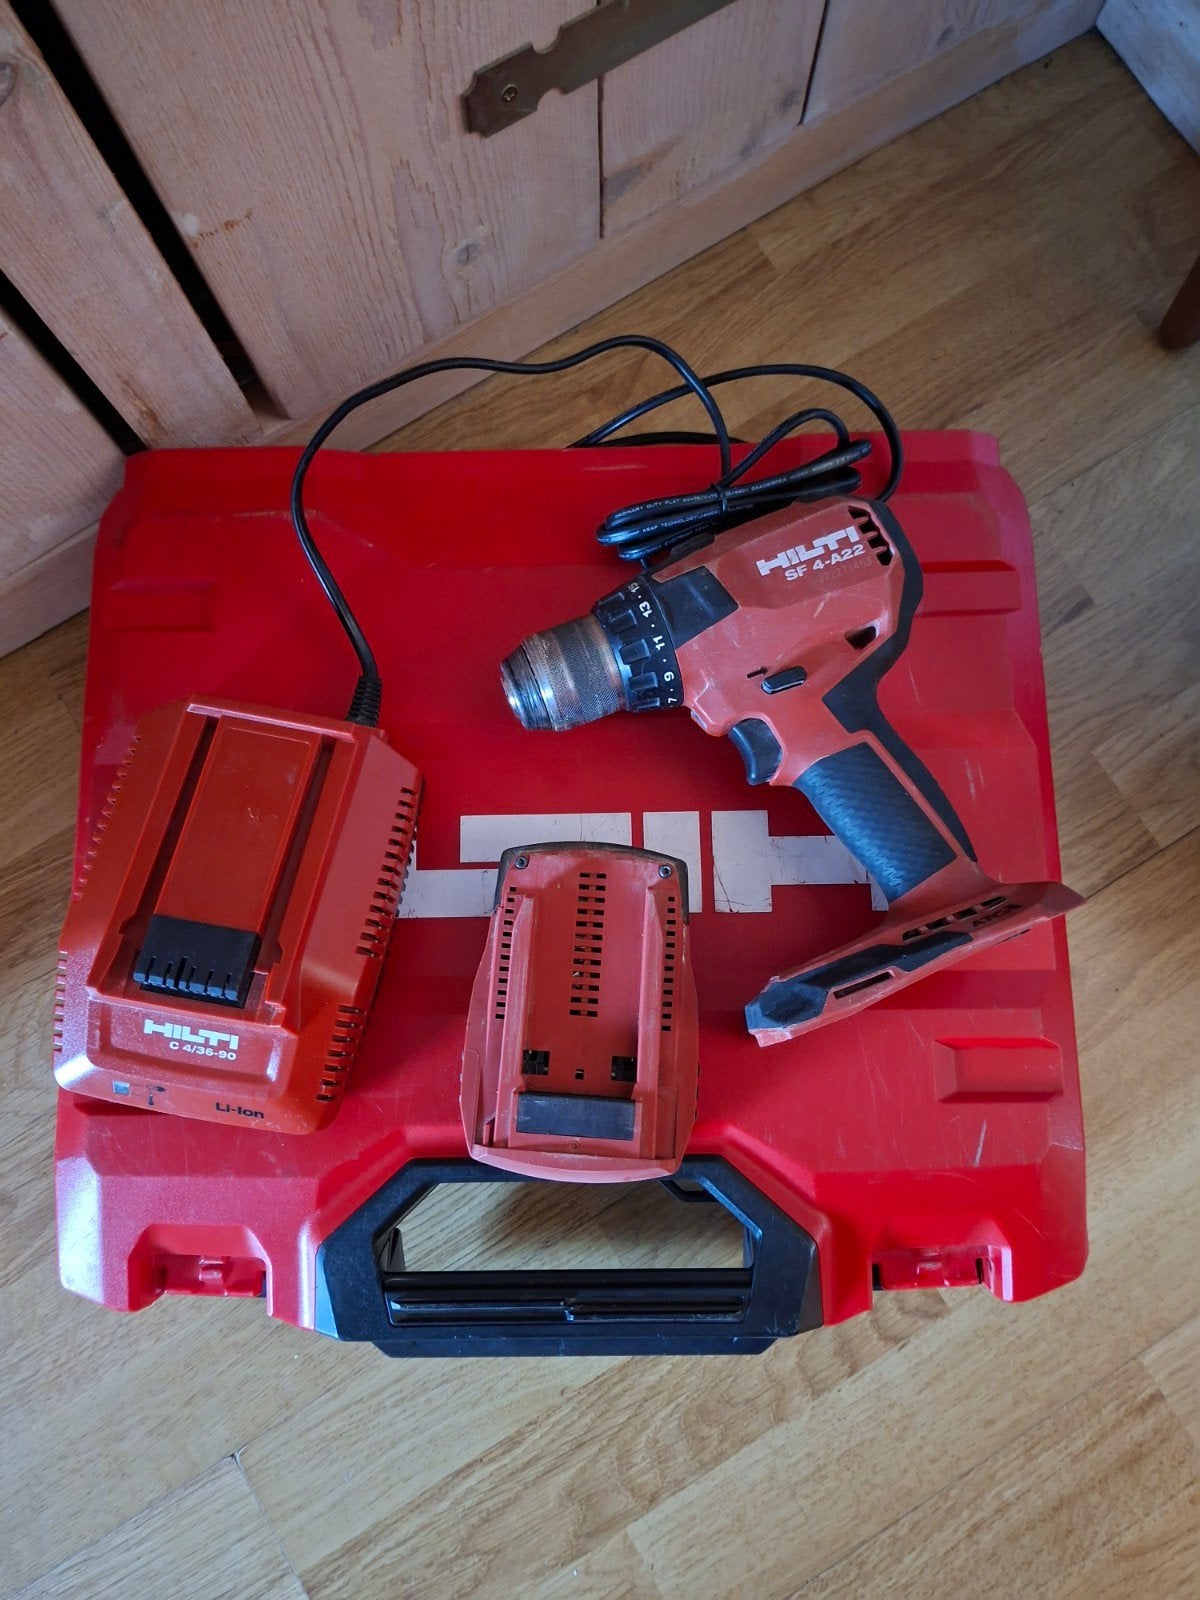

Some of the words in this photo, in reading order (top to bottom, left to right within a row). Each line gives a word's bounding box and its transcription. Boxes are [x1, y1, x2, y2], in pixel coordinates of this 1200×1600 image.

[756, 525, 860, 577] HILTI
[784, 564, 808, 581] SF
[813, 543, 866, 571] 4-A22
[638, 601, 653, 618] 13
[652, 635, 666, 651] 11
[143, 1019, 240, 1051] HILTI
[169, 1041, 180, 1051] C
[182, 1044, 238, 1061] 4/36-90
[215, 1102, 265, 1119] Li-Ion
